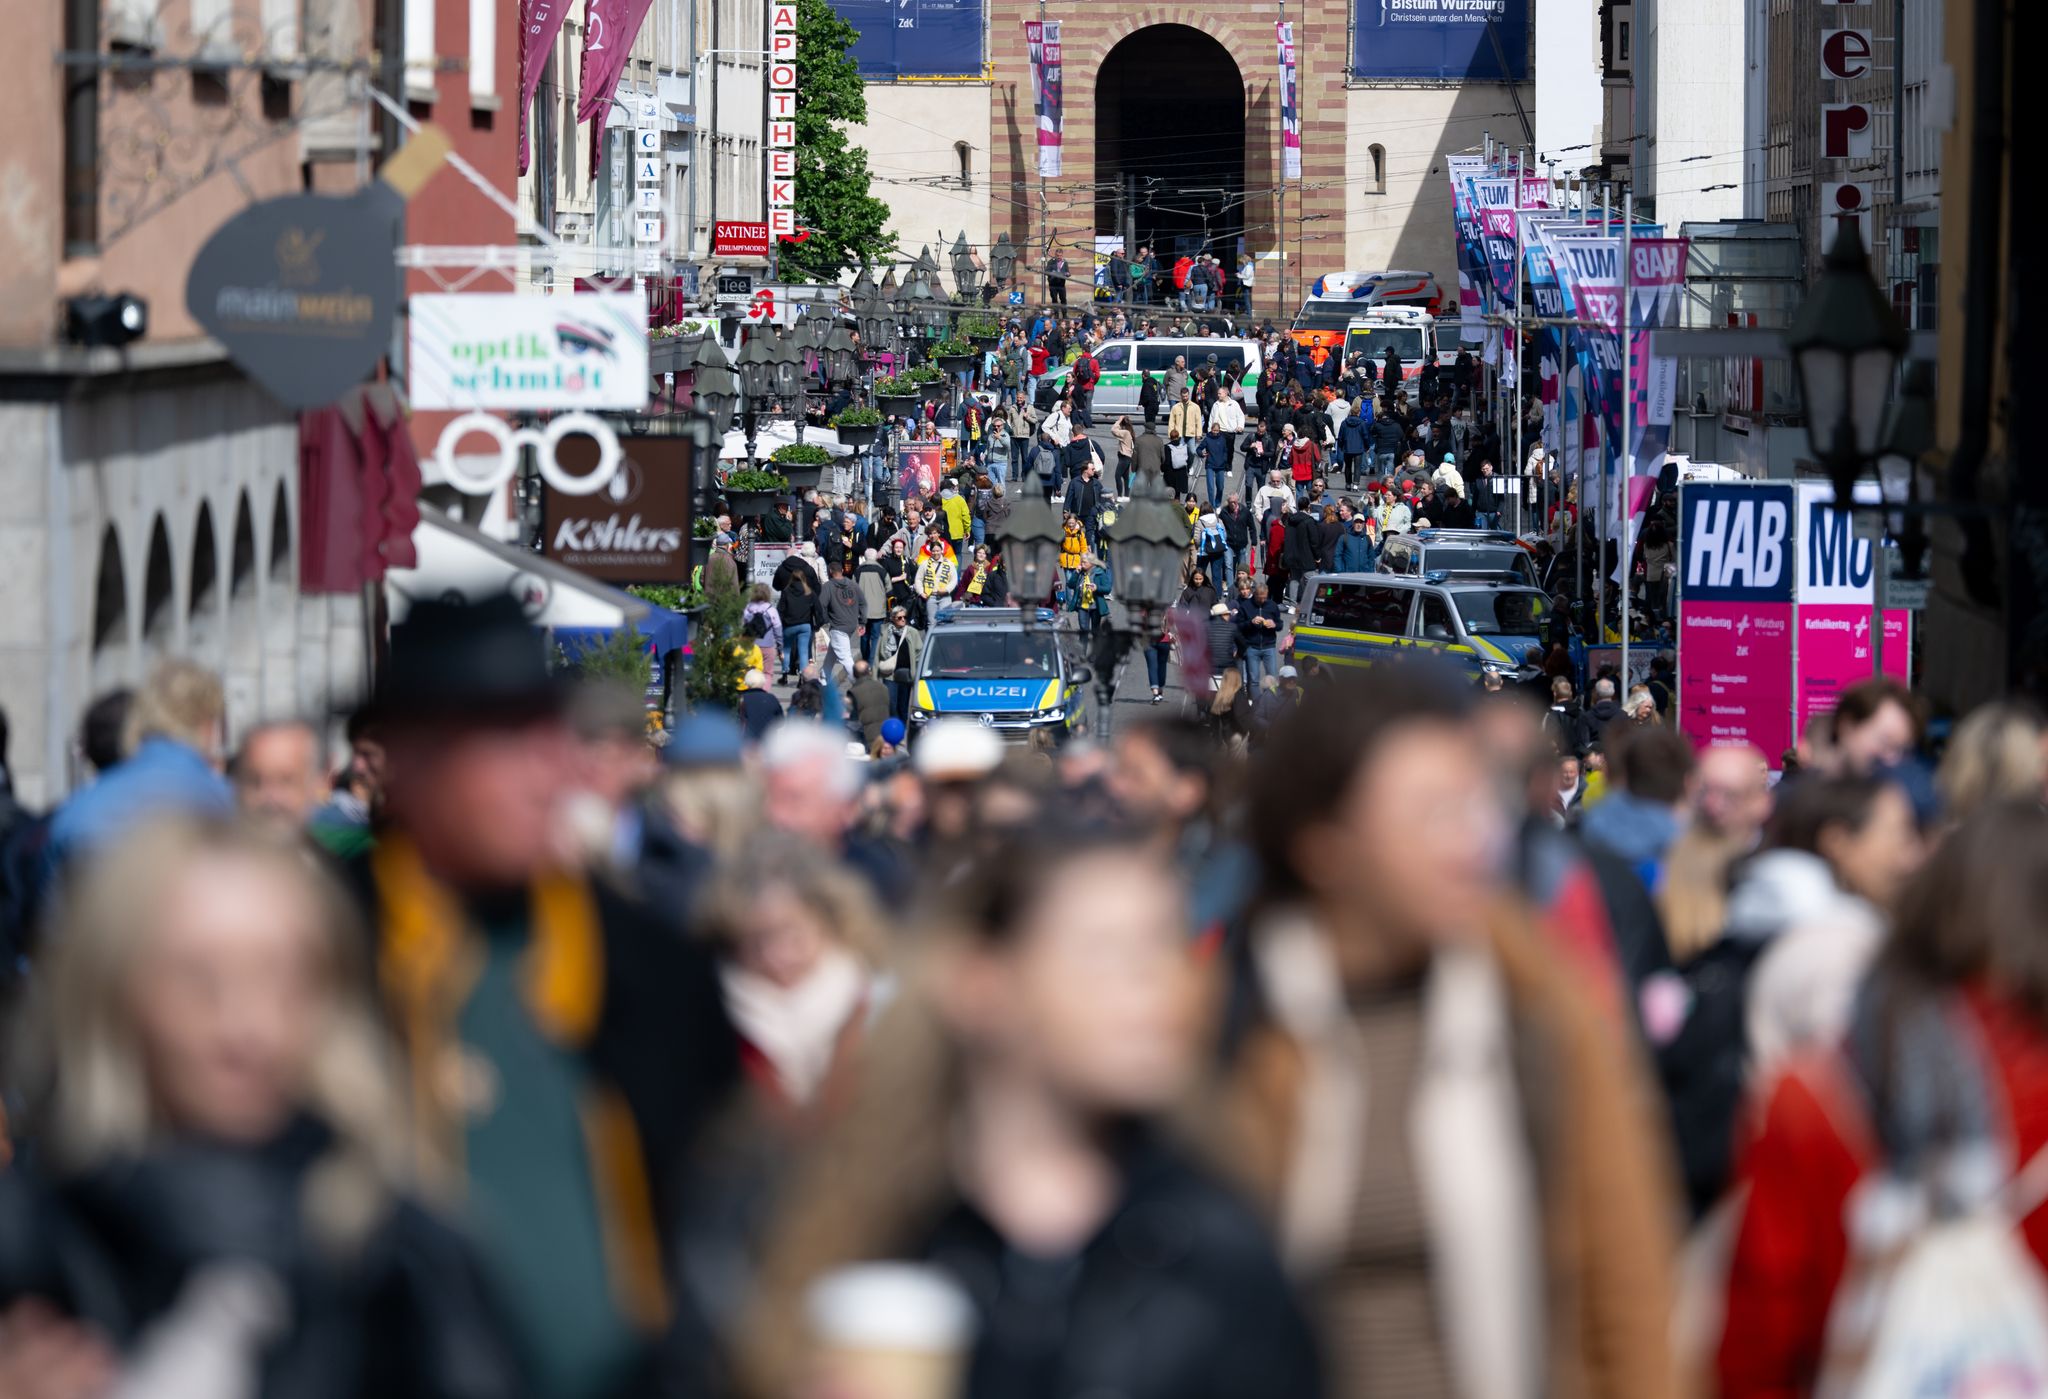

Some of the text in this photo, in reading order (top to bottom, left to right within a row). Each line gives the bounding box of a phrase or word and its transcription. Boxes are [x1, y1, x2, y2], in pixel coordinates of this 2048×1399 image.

[898, 18, 914, 28] ZdK
[1390, 13, 1427, 22] Christsein
[1428, 14, 1448, 22] unter
[1449, 13, 1463, 22] den
[773, 9, 793, 230] APOTHEKE
[718, 225, 767, 239] SATINEE
[718, 244, 767, 252] STRUMPFMODEN
[722, 277, 747, 293] Tee
[451, 334, 548, 365] optik
[450, 364, 604, 391] schmidt
[553, 513, 682, 552] Köhlers
[1687, 500, 1787, 588] HAB
[1809, 502, 1874, 588] MU
[946, 686, 1027, 698] POLIZEI
